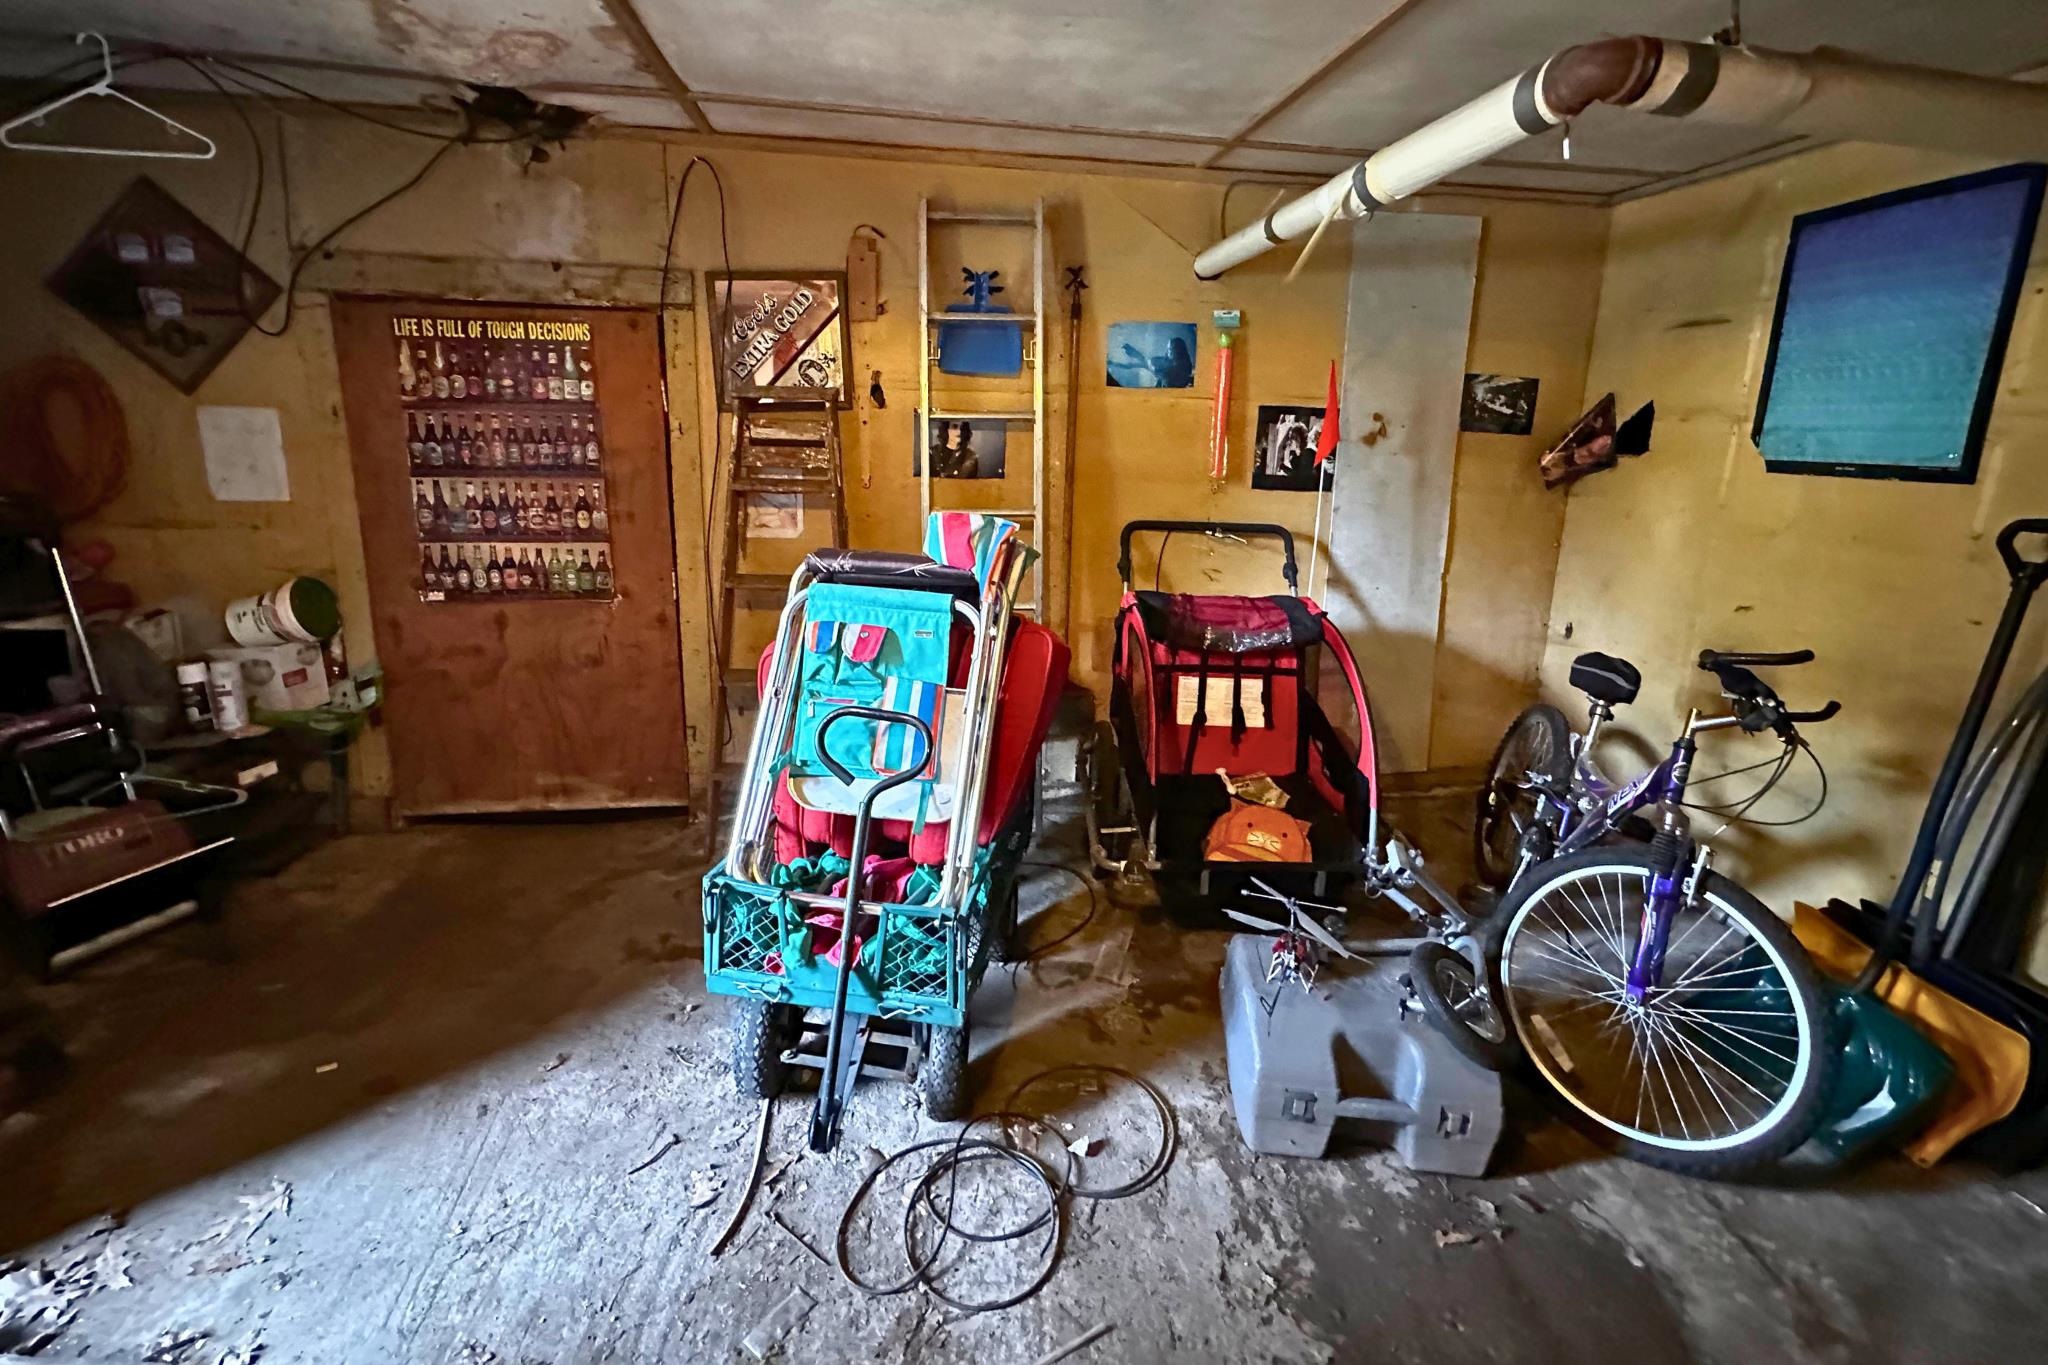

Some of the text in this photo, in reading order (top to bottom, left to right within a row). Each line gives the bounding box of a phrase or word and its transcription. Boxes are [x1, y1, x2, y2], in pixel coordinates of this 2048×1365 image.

[393, 318, 591, 342] LIFE IS FULL OF TOUGH DECISIONS
[730, 288, 813, 381] EXTRA GOLD
[732, 292, 778, 341] Coors
